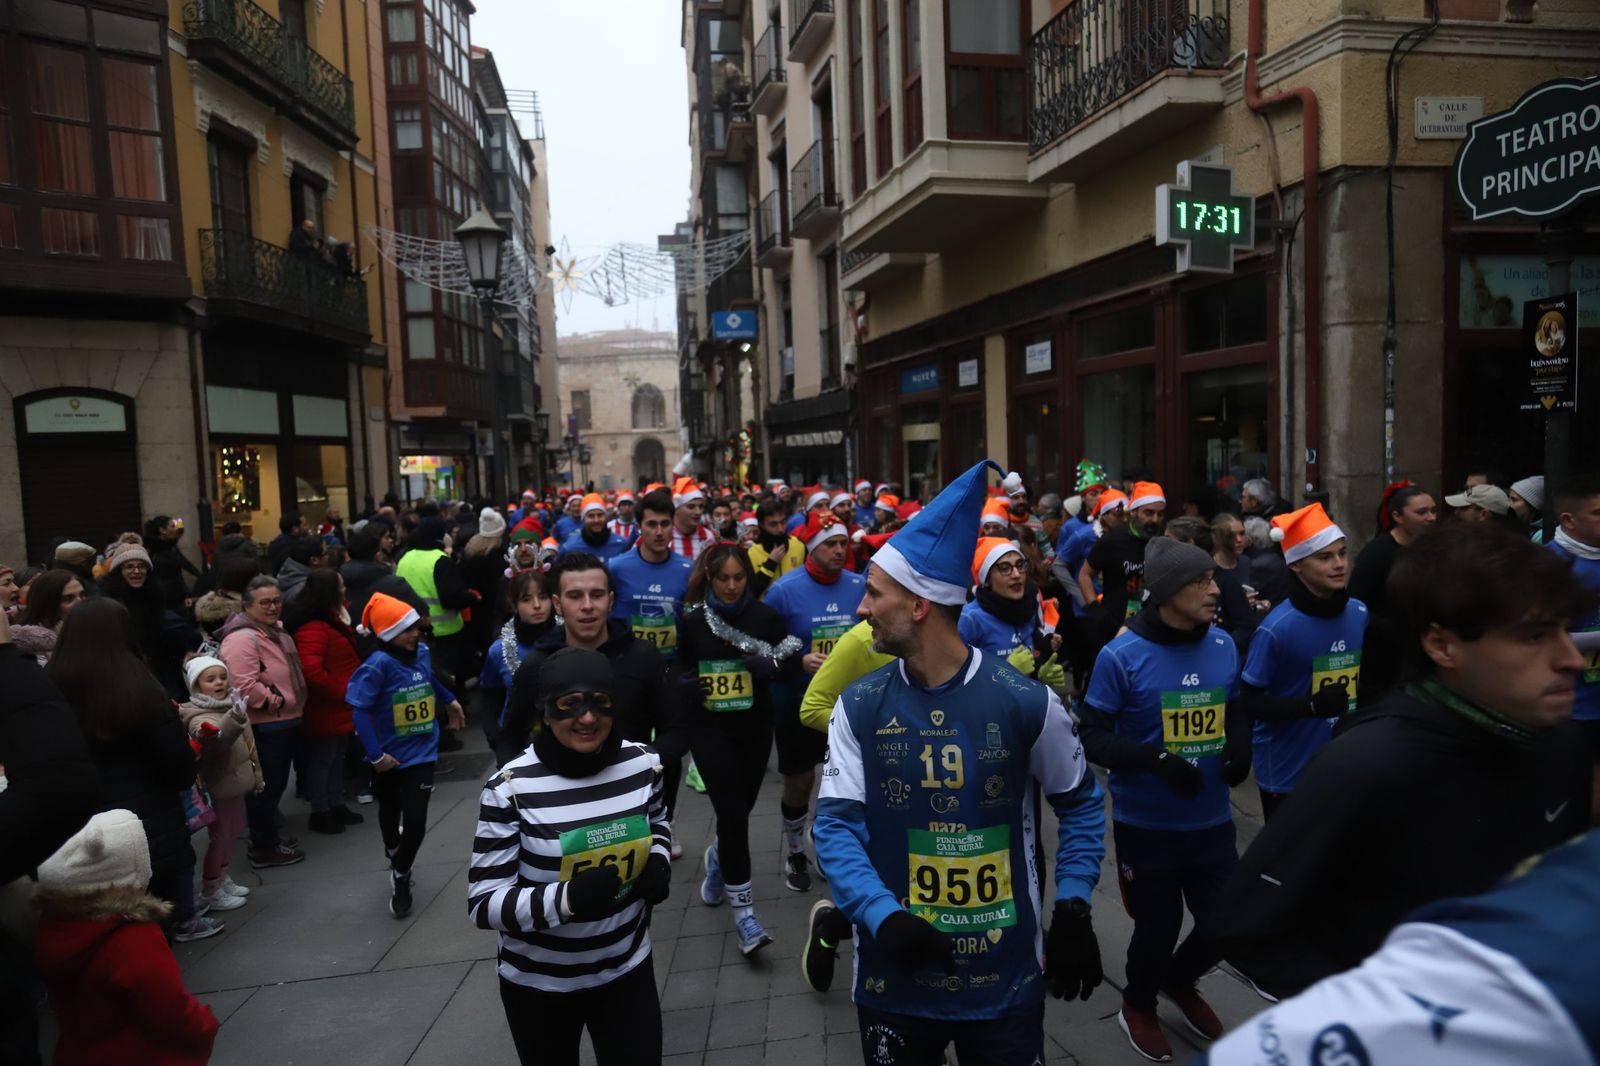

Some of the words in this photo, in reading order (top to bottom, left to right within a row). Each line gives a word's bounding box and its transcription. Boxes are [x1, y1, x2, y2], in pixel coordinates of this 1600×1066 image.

[1439, 103, 1468, 112] CALLE
[1444, 114, 1457, 122] DE
[1496, 104, 1600, 157] TEATRO
[1176, 201, 1240, 234] 17:31
[648, 583, 662, 593] 46
[826, 603, 839, 613] 46
[1330, 640, 1346, 653] 46
[1181, 673, 1200, 687] 46
[404, 701, 429, 722] 68
[1169, 709, 1217, 737] 1192
[876, 727, 908, 735] MERCURY
[919, 728, 958, 737] MORALEJO
[876, 742, 911, 751] ANGEL
[1182, 745, 1201, 753] CAJA
[919, 744, 965, 789] 19
[587, 835, 604, 844] CAJA
[605, 830, 628, 840] RURAL
[936, 843, 956, 851] CAJA
[958, 842, 985, 852] RURAL
[916, 864, 998, 906] 956
[940, 913, 970, 925] CAJA
[972, 908, 1010, 924] RURAL
[951, 937, 989, 954] ORA
[969, 971, 1000, 984] Senda
